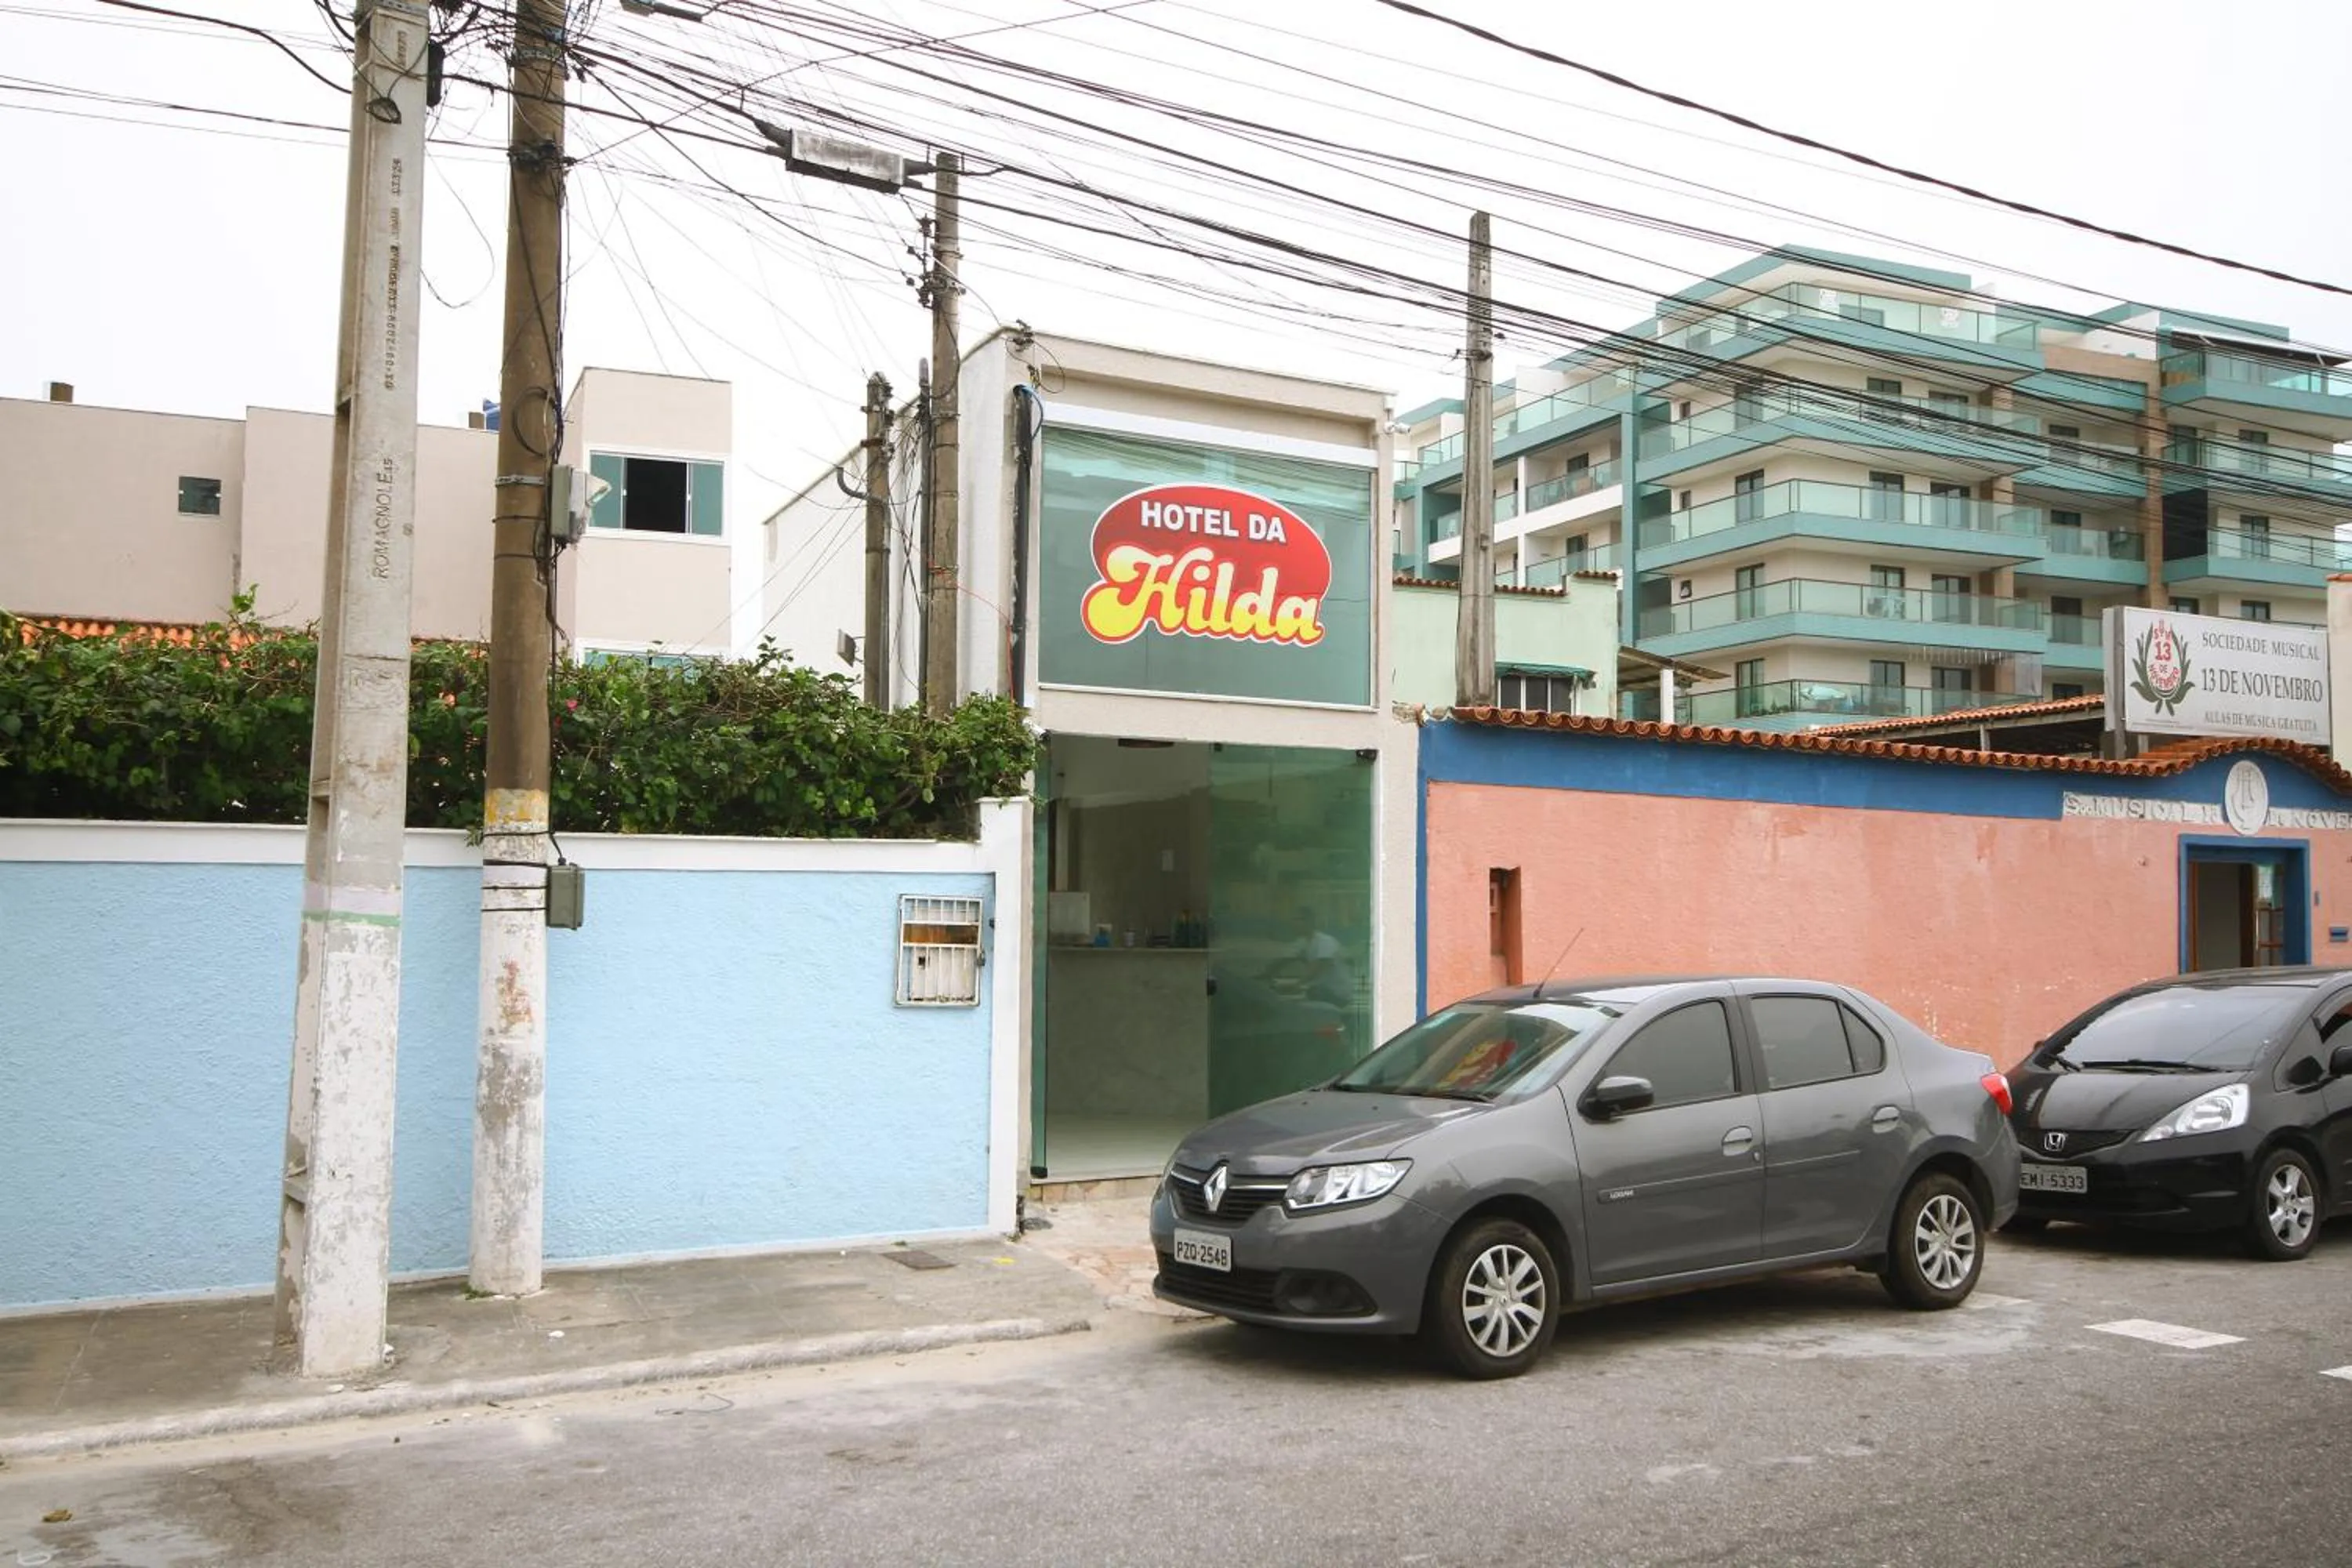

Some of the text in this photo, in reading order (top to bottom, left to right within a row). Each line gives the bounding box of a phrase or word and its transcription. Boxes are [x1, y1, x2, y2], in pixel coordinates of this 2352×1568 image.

[1141, 500, 1287, 543] HOTEL DA
[1087, 545, 1324, 641] Hilda
[2154, 641, 2172, 660] 13
[2201, 632, 2321, 661] SOCIEDADE MUSICAL
[2201, 667, 2323, 702] 13 DE NOVEMBRO
